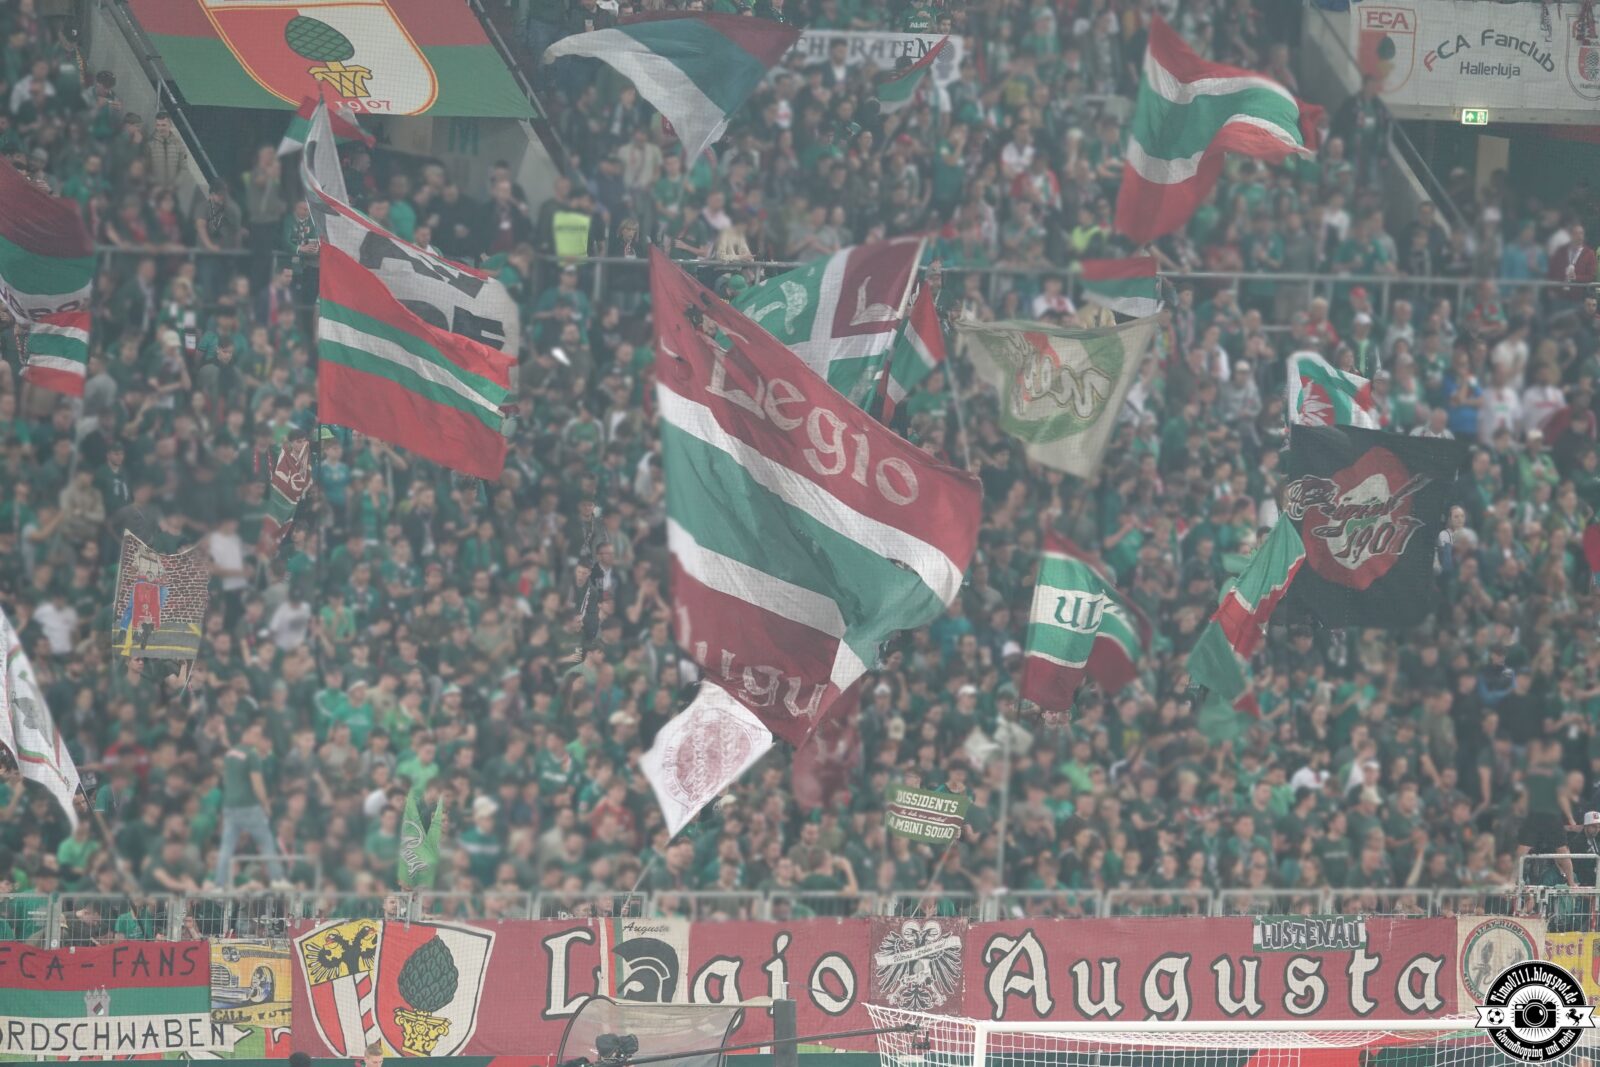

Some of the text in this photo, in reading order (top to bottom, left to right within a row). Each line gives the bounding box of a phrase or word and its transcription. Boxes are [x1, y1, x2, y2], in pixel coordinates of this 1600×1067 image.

[1367, 11, 1409, 30] FCA
[1423, 34, 1471, 72] FCA
[1480, 29, 1555, 72] Fanclub
[1459, 61, 1521, 79] Hallerluja
[896, 790, 959, 813] DISSIDENTS
[888, 816, 924, 836] AMBINI
[1260, 916, 1362, 949] LUSTENAU
[112, 946, 199, 977] FANS
[541, 926, 1446, 1034] Lgio Augusta
[0, 1018, 225, 1051] RDSCHWABEN
